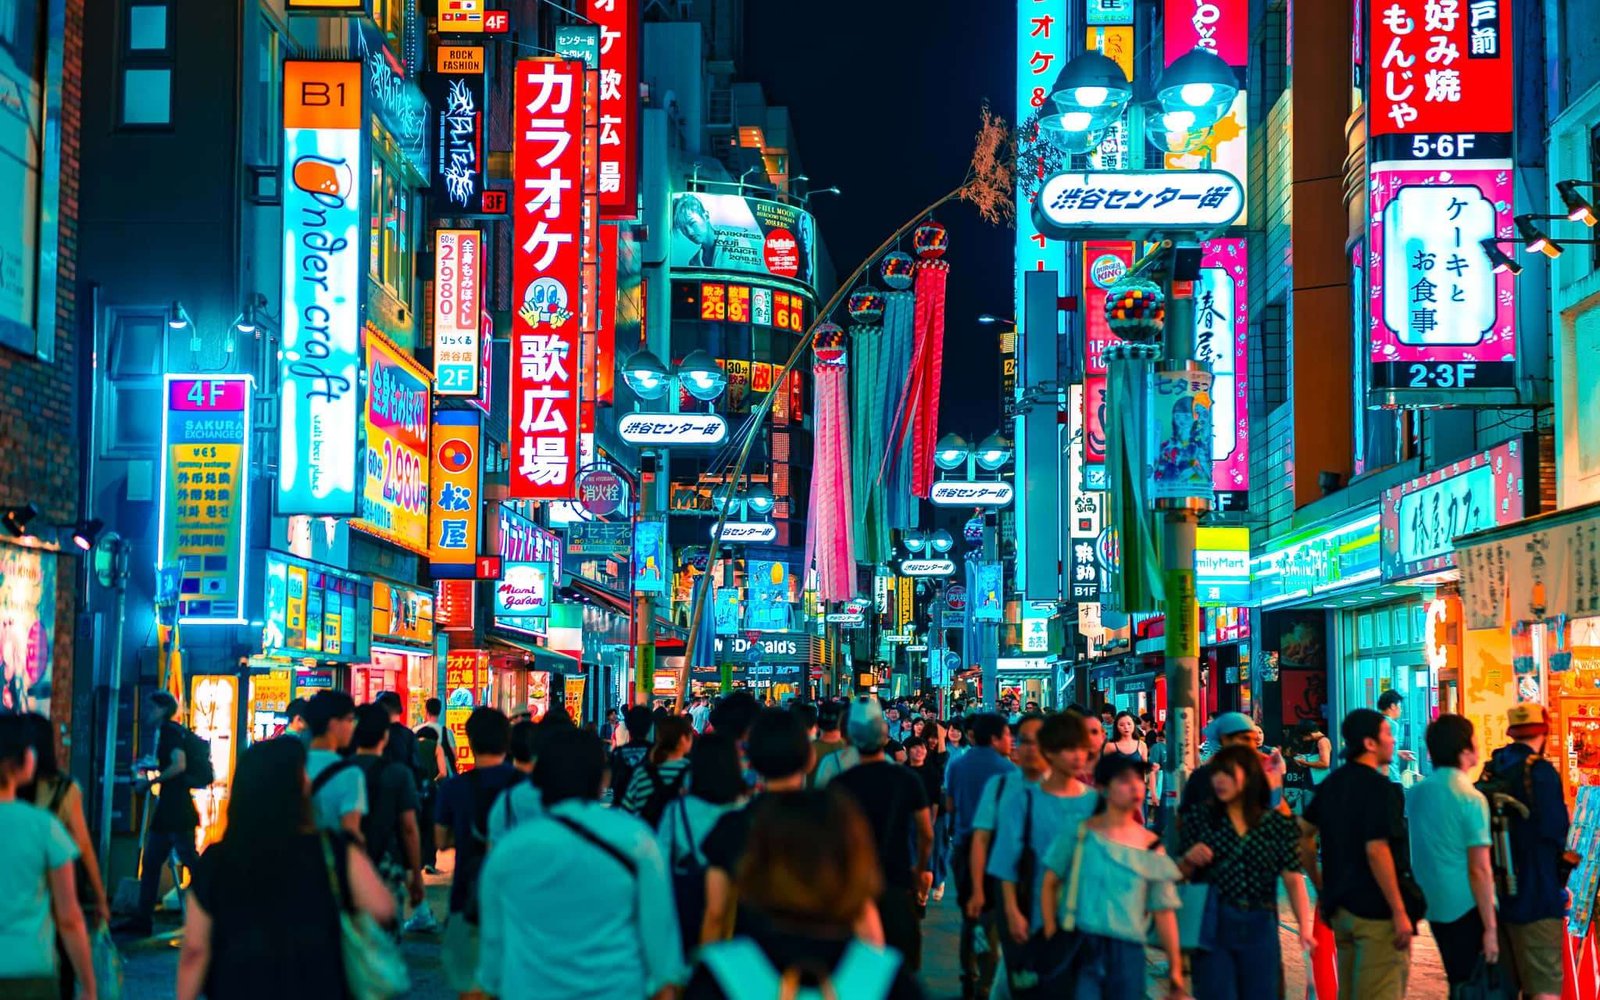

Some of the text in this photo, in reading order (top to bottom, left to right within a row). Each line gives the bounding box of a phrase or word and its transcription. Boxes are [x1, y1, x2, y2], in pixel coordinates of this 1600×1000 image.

[486, 16, 506, 29] 4F
[558, 35, 595, 46] センター街
[450, 50, 473, 59] ROCK
[443, 61, 480, 70] FASHION
[1381, 4, 1418, 129] もんじゃ
[301, 82, 345, 107] B1
[523, 63, 573, 272] カラオケ
[486, 194, 503, 209] 3F
[1051, 187, 1233, 210] 渋谷センター街
[1446, 196, 1470, 302] ケーキと
[1096, 262, 1122, 275] BURGER
[1097, 270, 1122, 282] KING
[1410, 249, 1438, 334] お食事
[289, 305, 350, 403] craft
[439, 351, 473, 362] 渋谷店
[728, 362, 749, 374] 30分
[443, 368, 470, 387] 2F
[187, 380, 226, 406] 4F
[519, 333, 571, 487] 歌広場
[185, 420, 244, 430] SAKURA
[623, 422, 721, 436] 渋谷センター街
[582, 484, 620, 502] 消火栓
[935, 488, 1009, 498] 渋谷センター街
[438, 482, 471, 548] 松屋
[719, 527, 773, 536] 谷センター街
[481, 560, 498, 576] 1F
[497, 583, 536, 595] Miami
[1074, 586, 1097, 596] B1F
[503, 597, 547, 609] Garden
